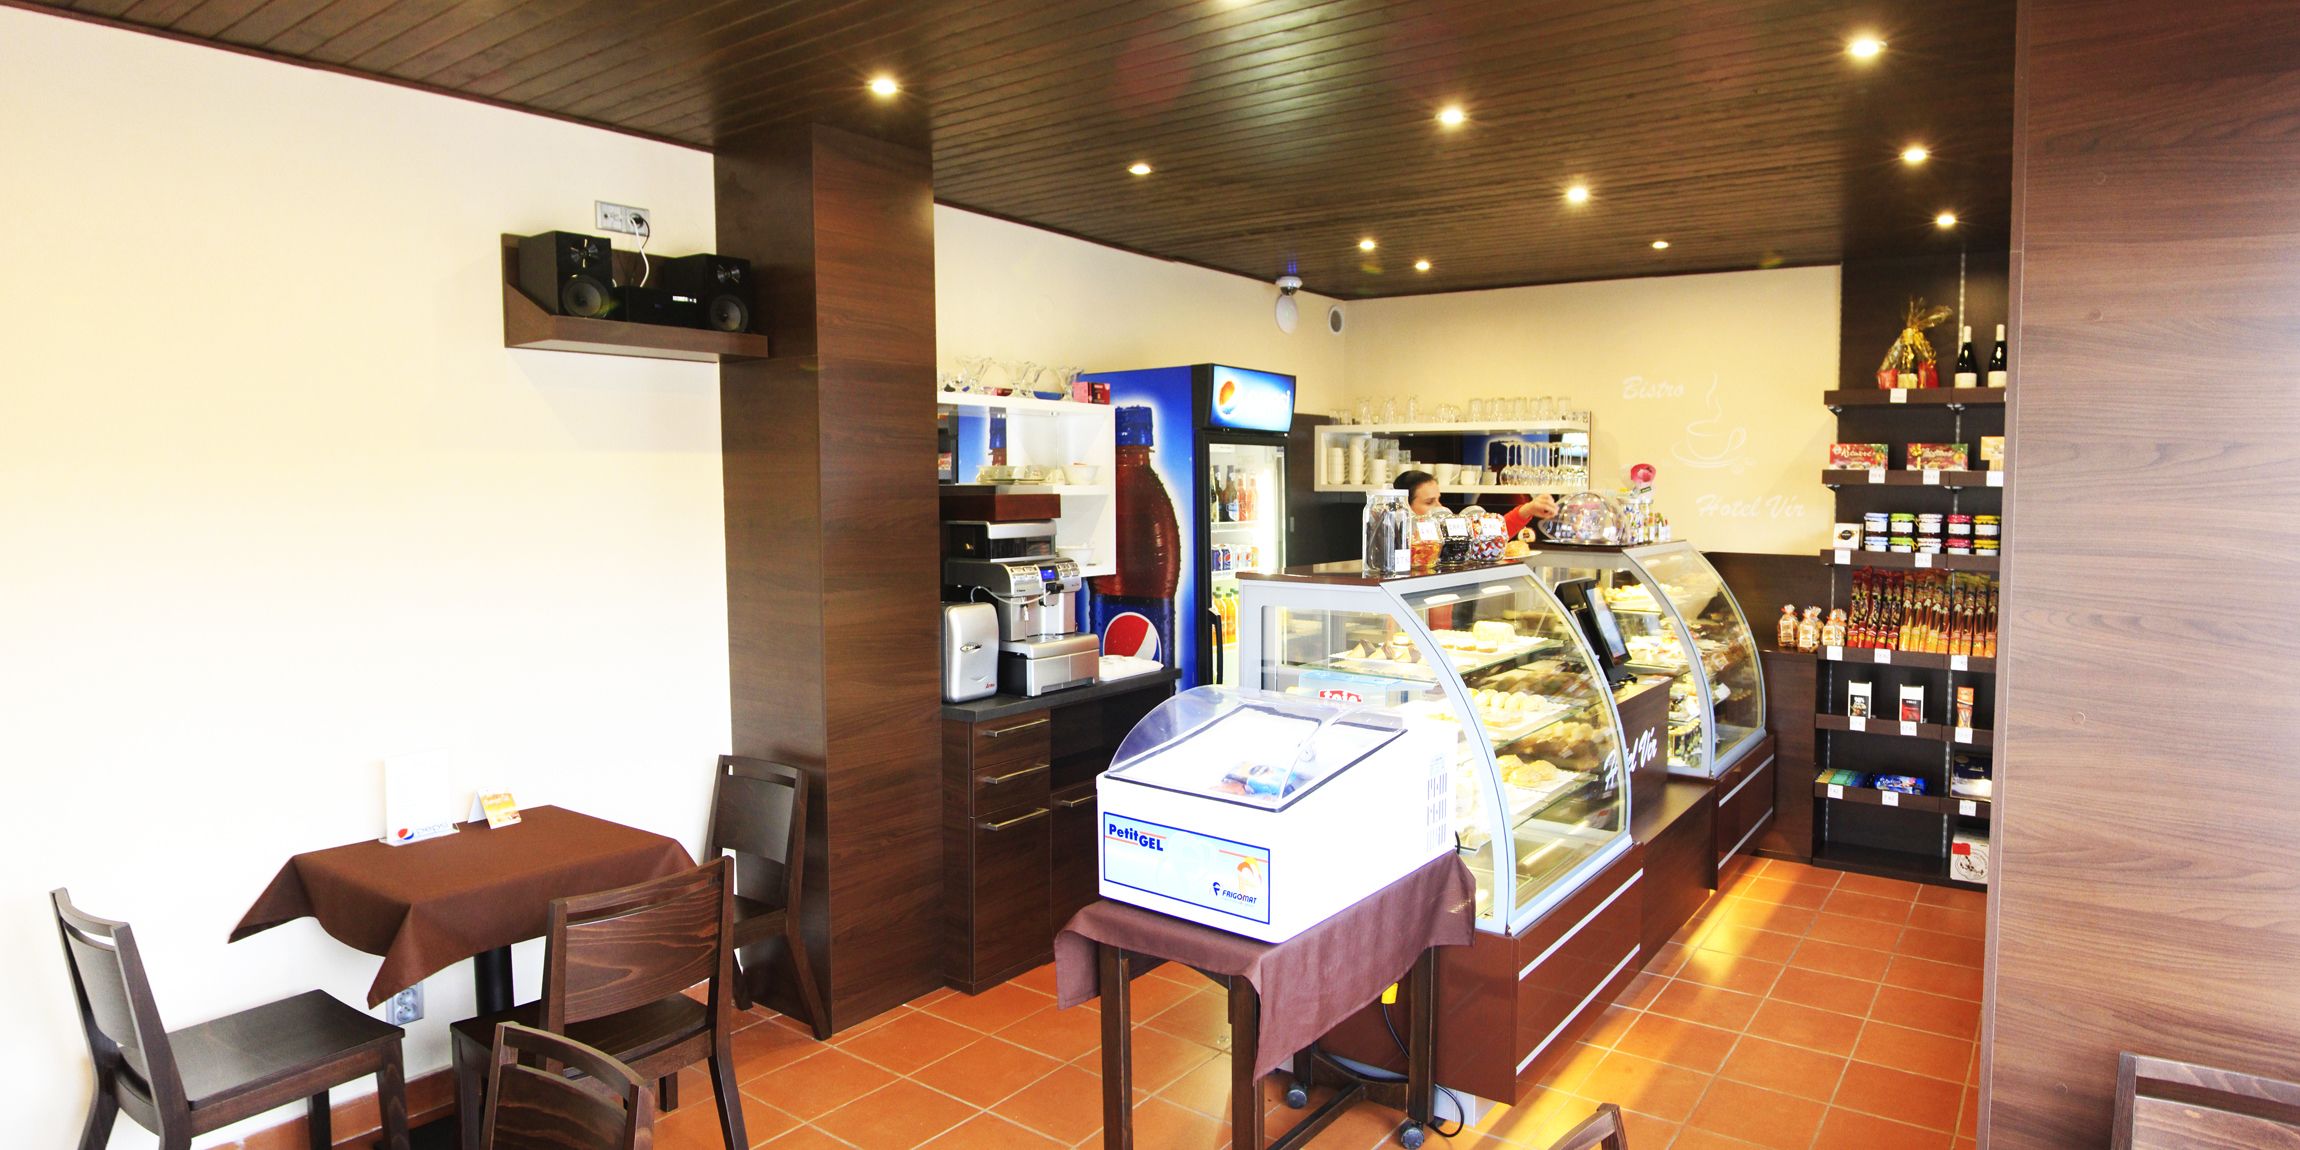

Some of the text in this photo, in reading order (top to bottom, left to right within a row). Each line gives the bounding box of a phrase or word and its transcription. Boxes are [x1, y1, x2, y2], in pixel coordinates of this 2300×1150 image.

[1622, 376, 1684, 400] Bistro
[1695, 494, 1760, 517] Hotel
[1109, 823, 1164, 851] PetitGEL
[1222, 889, 1257, 904] FRIGOMAT
